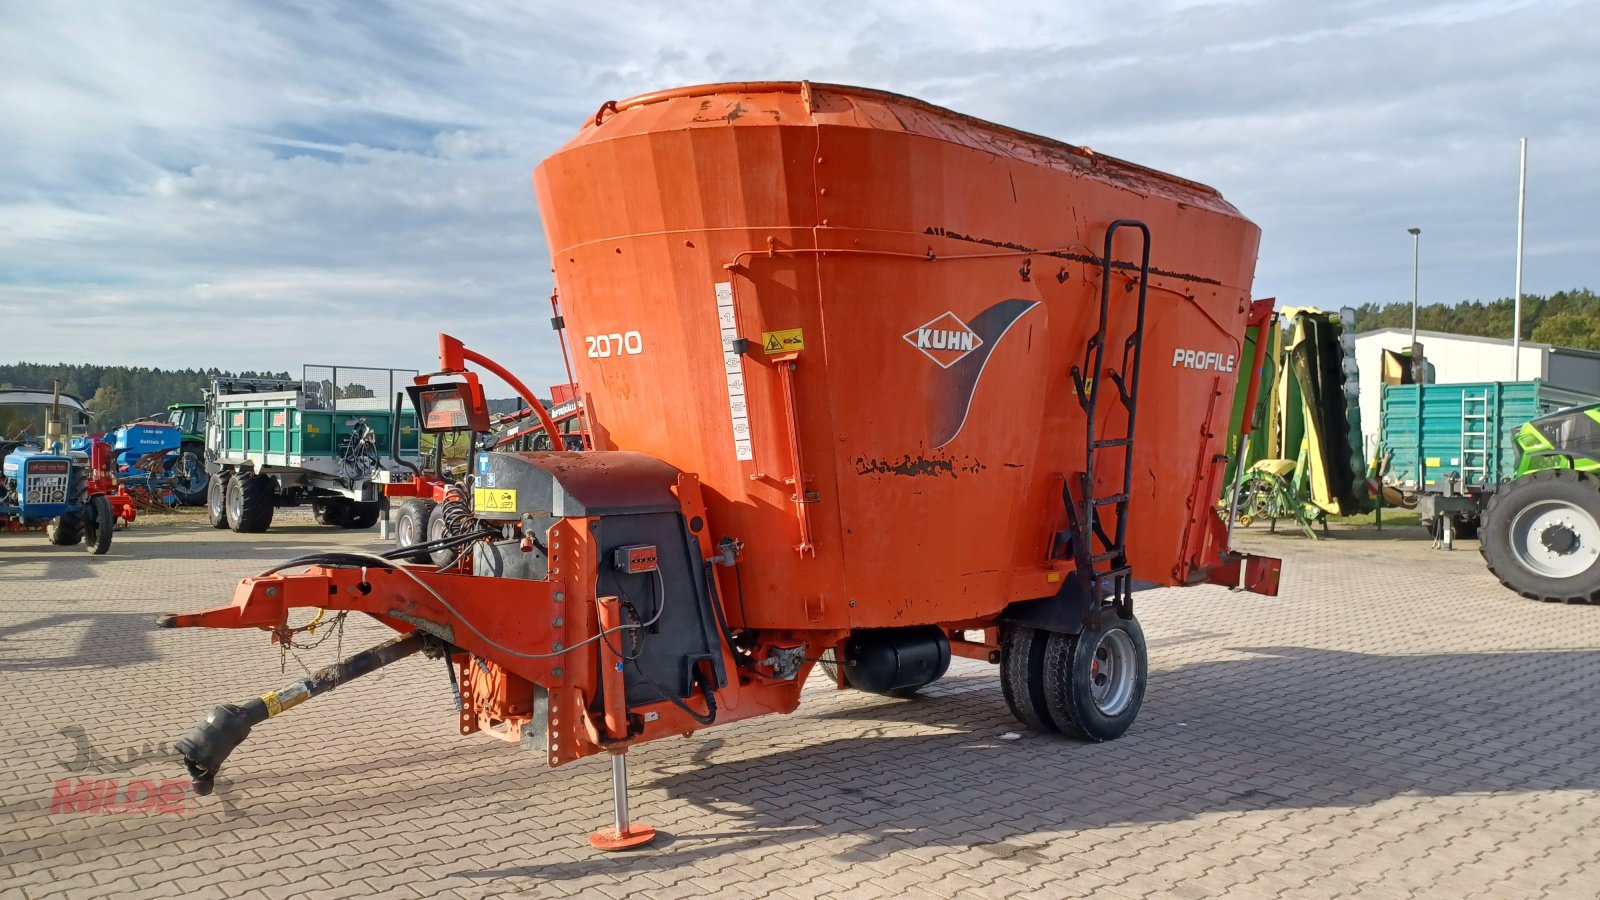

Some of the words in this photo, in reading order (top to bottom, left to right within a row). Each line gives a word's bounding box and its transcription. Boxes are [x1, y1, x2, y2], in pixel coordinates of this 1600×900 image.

[585, 330, 643, 359] 2070
[917, 328, 974, 351] KUHN
[1172, 348, 1235, 373] PROFILE
